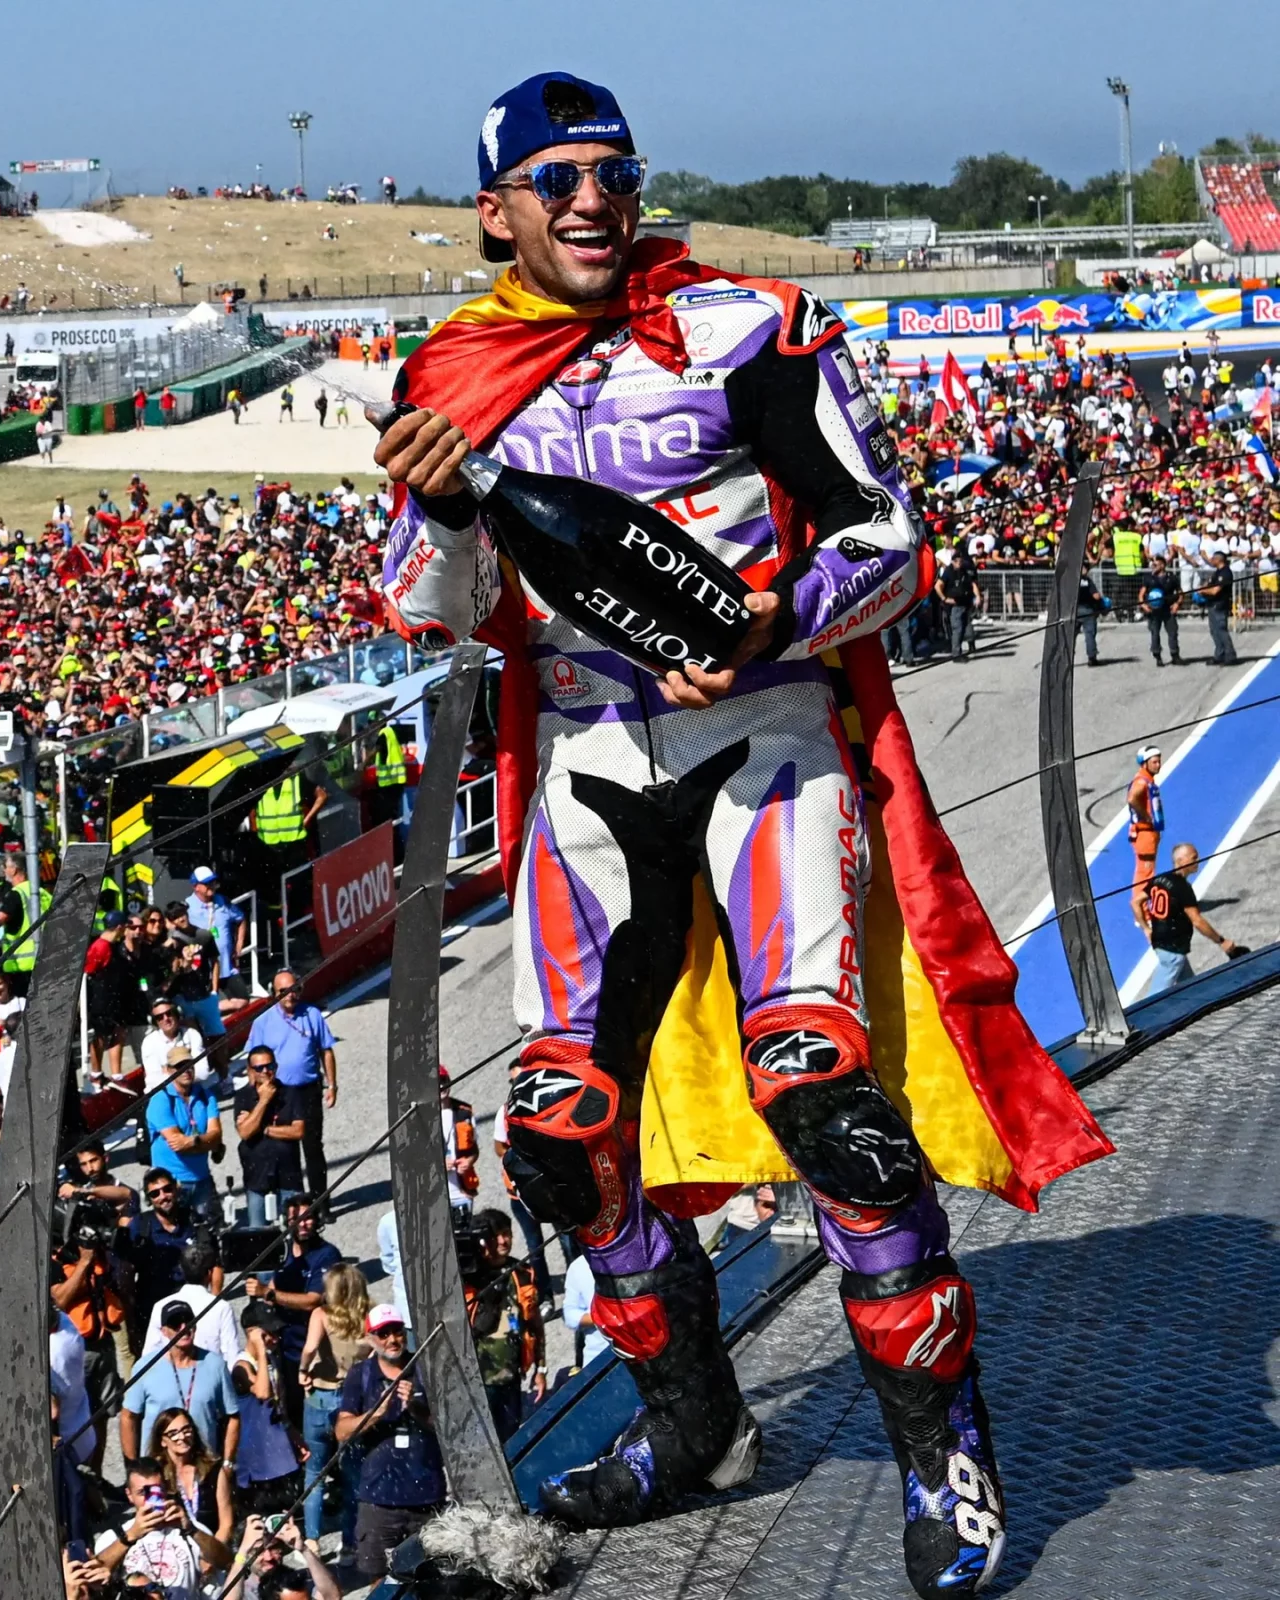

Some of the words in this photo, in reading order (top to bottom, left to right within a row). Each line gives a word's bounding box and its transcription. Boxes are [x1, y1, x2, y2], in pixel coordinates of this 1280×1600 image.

[567, 124, 620, 134] MICHELIN
[690, 291, 749, 303] MICHELIN
[900, 309, 949, 333] Red
[953, 305, 1001, 331] Bull
[51, 328, 116, 345] PROSECCO
[825, 557, 883, 620] prima
[808, 576, 904, 654] PRAMAC
[552, 685, 589, 698] PRAMAC
[322, 861, 390, 937] Lenovo
[833, 788, 861, 1011] PRAMAC
